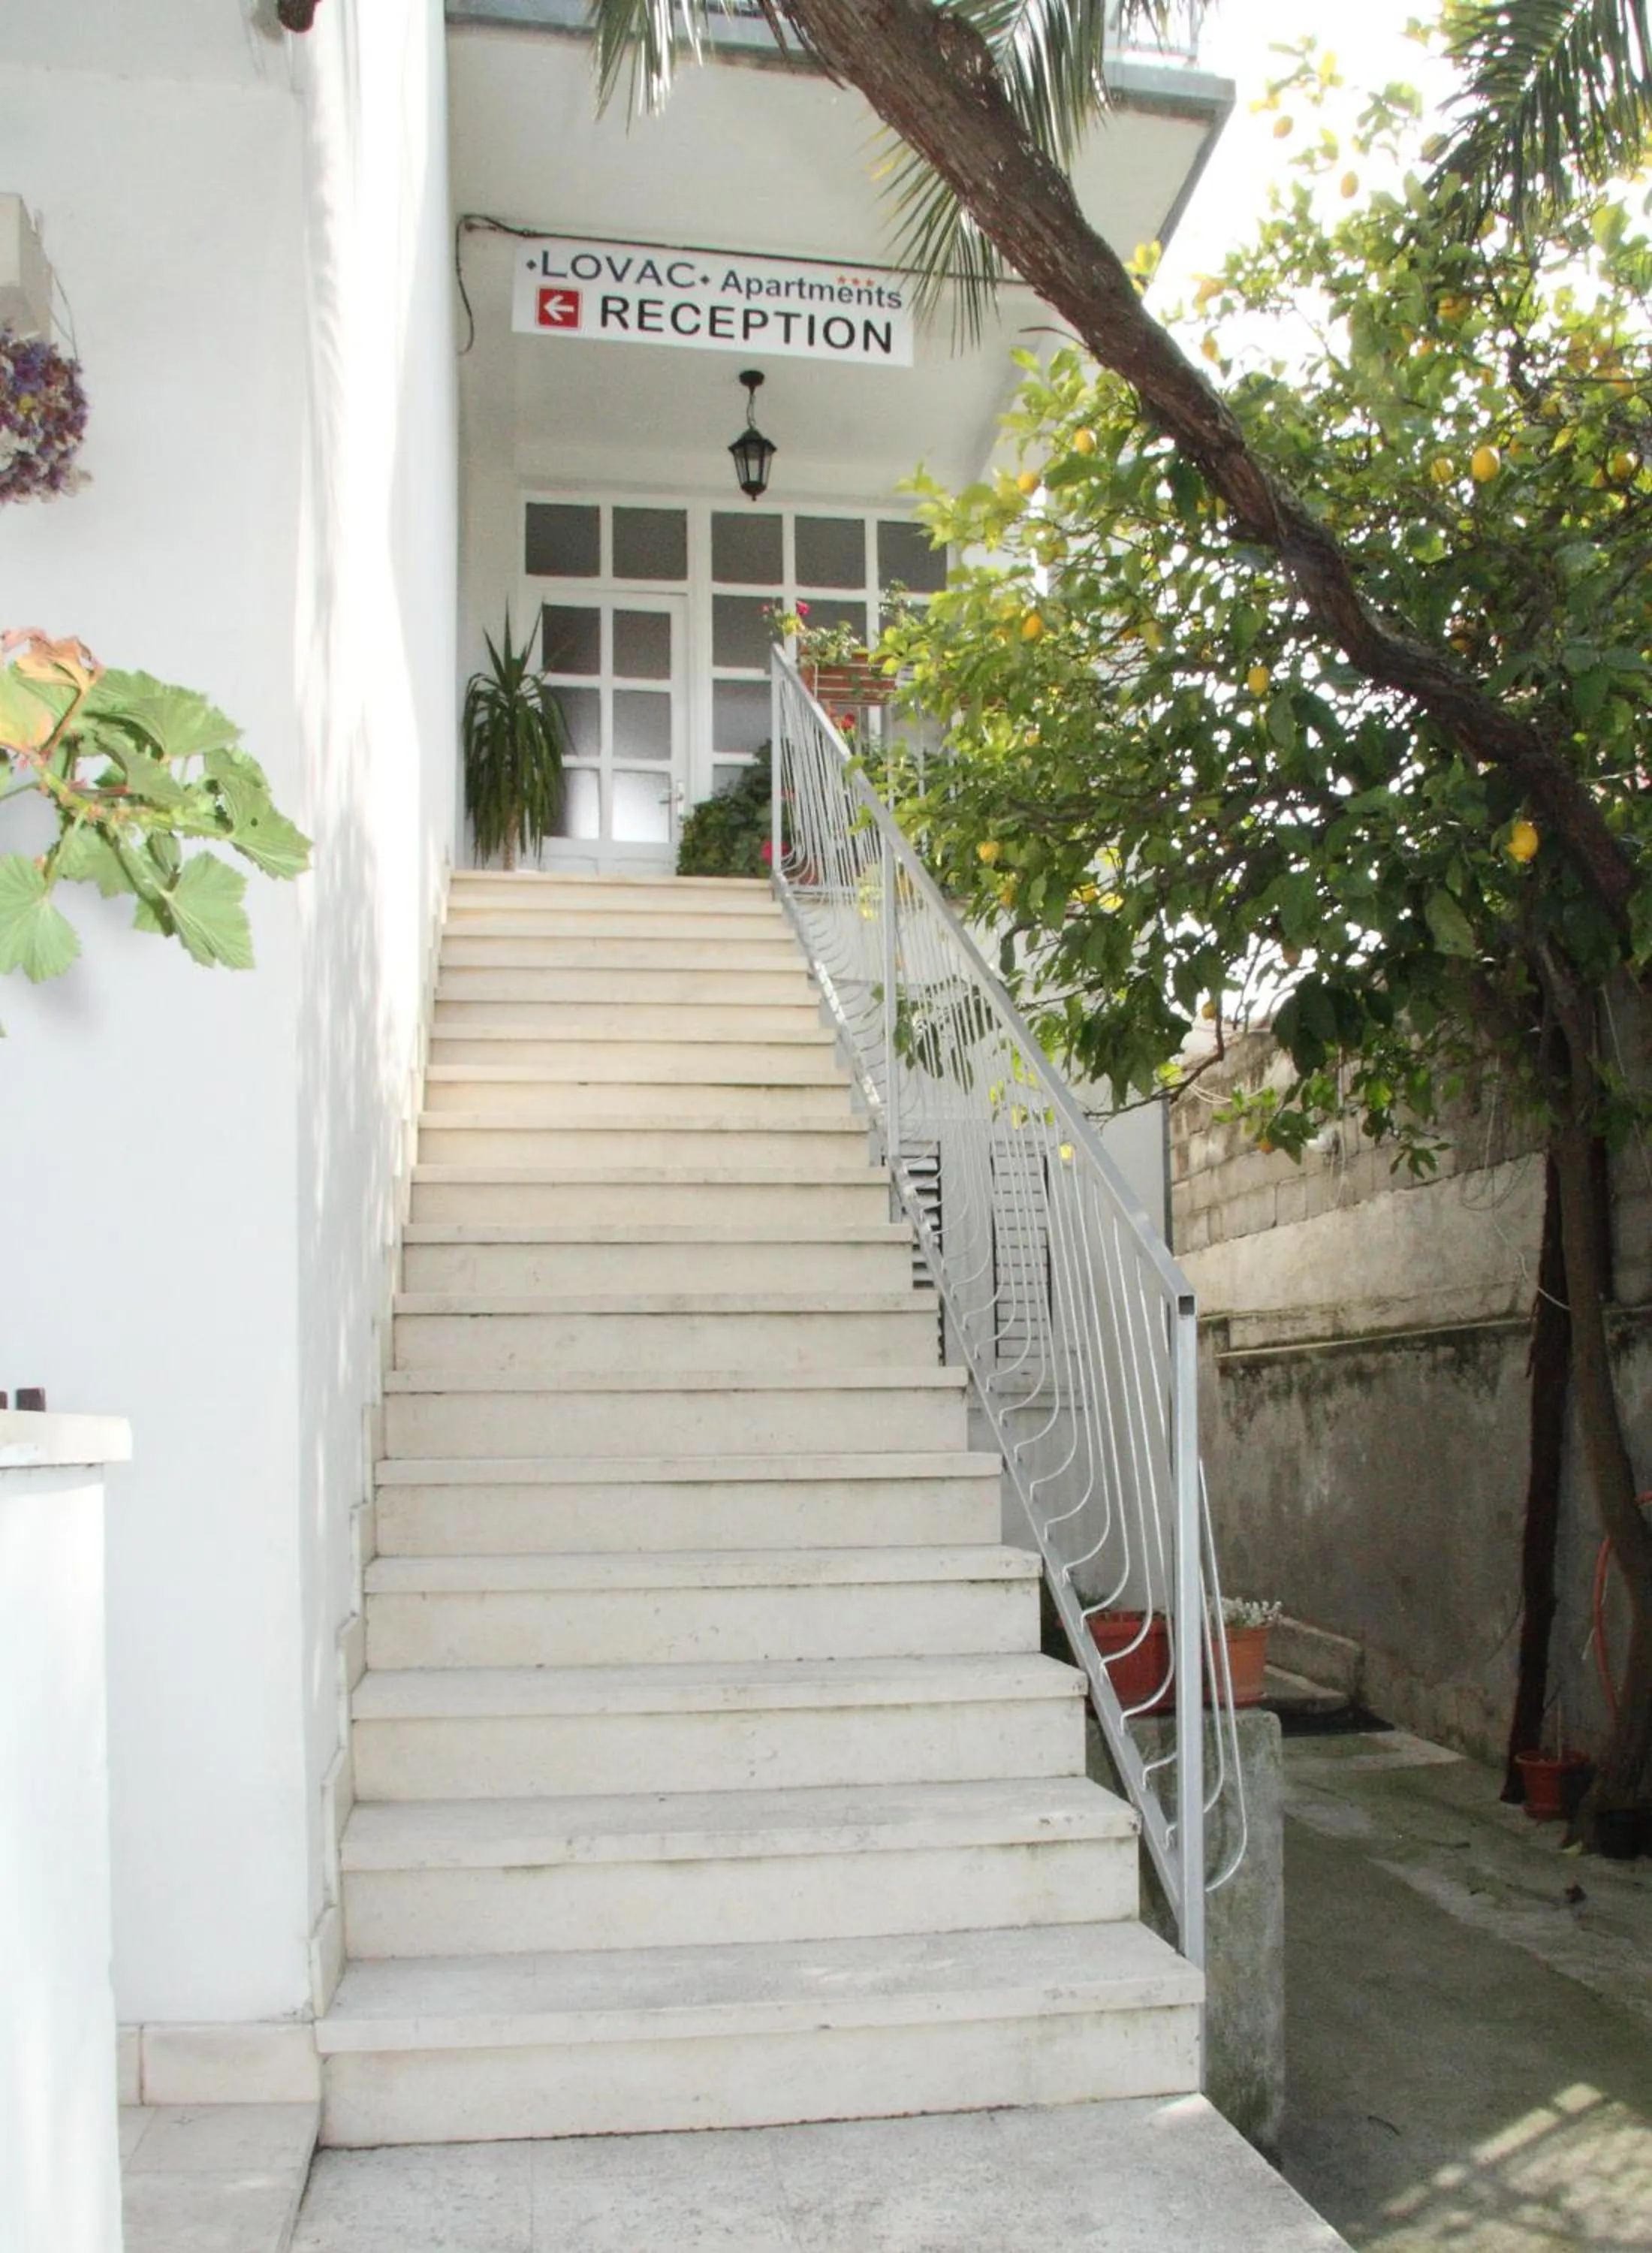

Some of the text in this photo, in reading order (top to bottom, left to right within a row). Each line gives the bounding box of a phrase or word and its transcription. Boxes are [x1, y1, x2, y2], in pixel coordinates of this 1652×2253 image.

[541, 250, 903, 309] LOVAC Apartments
[601, 295, 892, 354] RECEPTION
